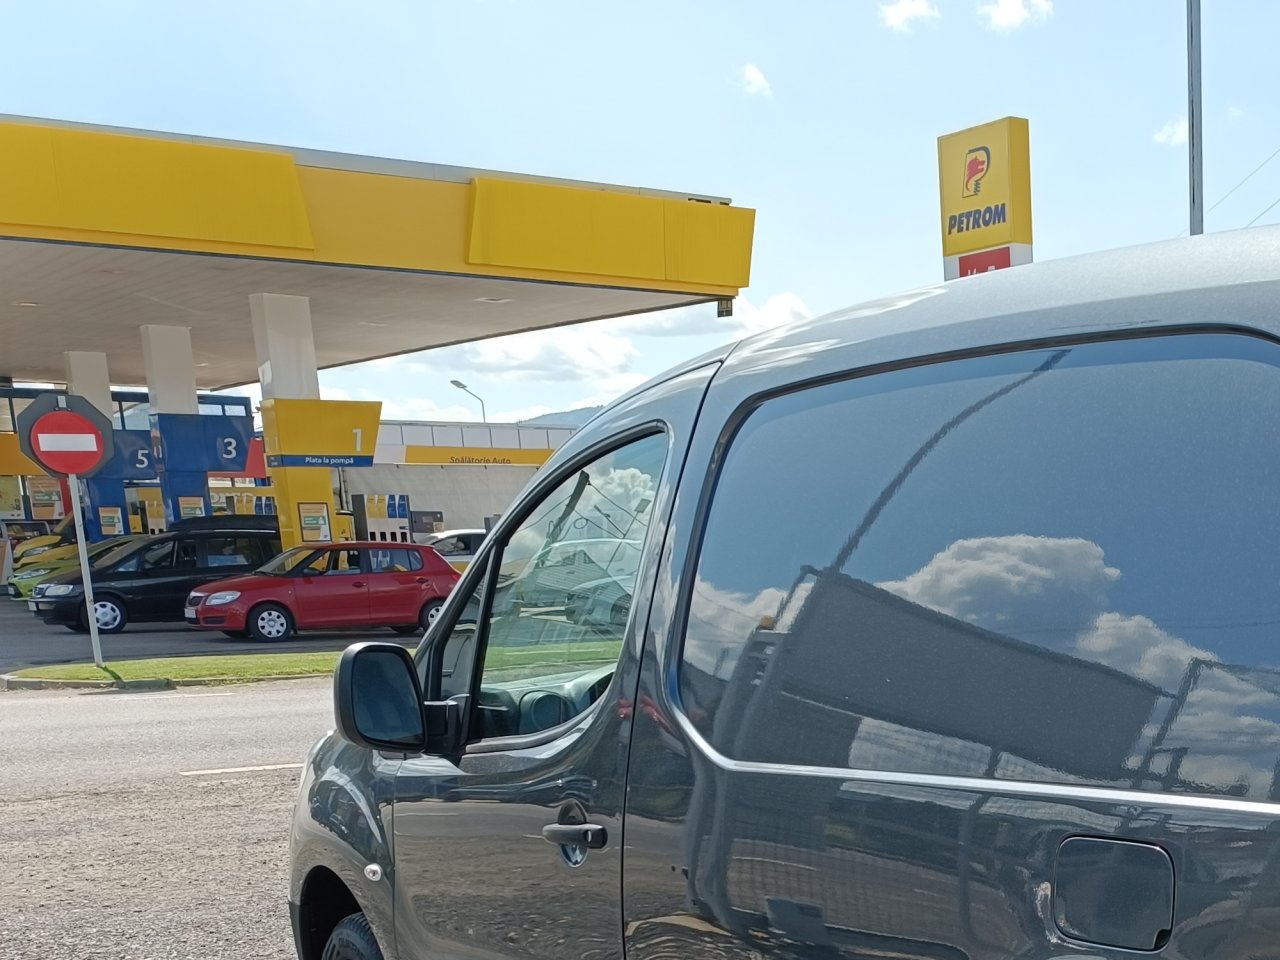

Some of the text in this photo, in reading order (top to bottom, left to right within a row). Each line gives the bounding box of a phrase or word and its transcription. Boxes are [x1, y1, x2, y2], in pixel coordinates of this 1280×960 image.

[947, 203, 1006, 235] PETROM
[222, 438, 237, 459] 3
[352, 428, 363, 452] 1
[135, 450, 149, 469] 5
